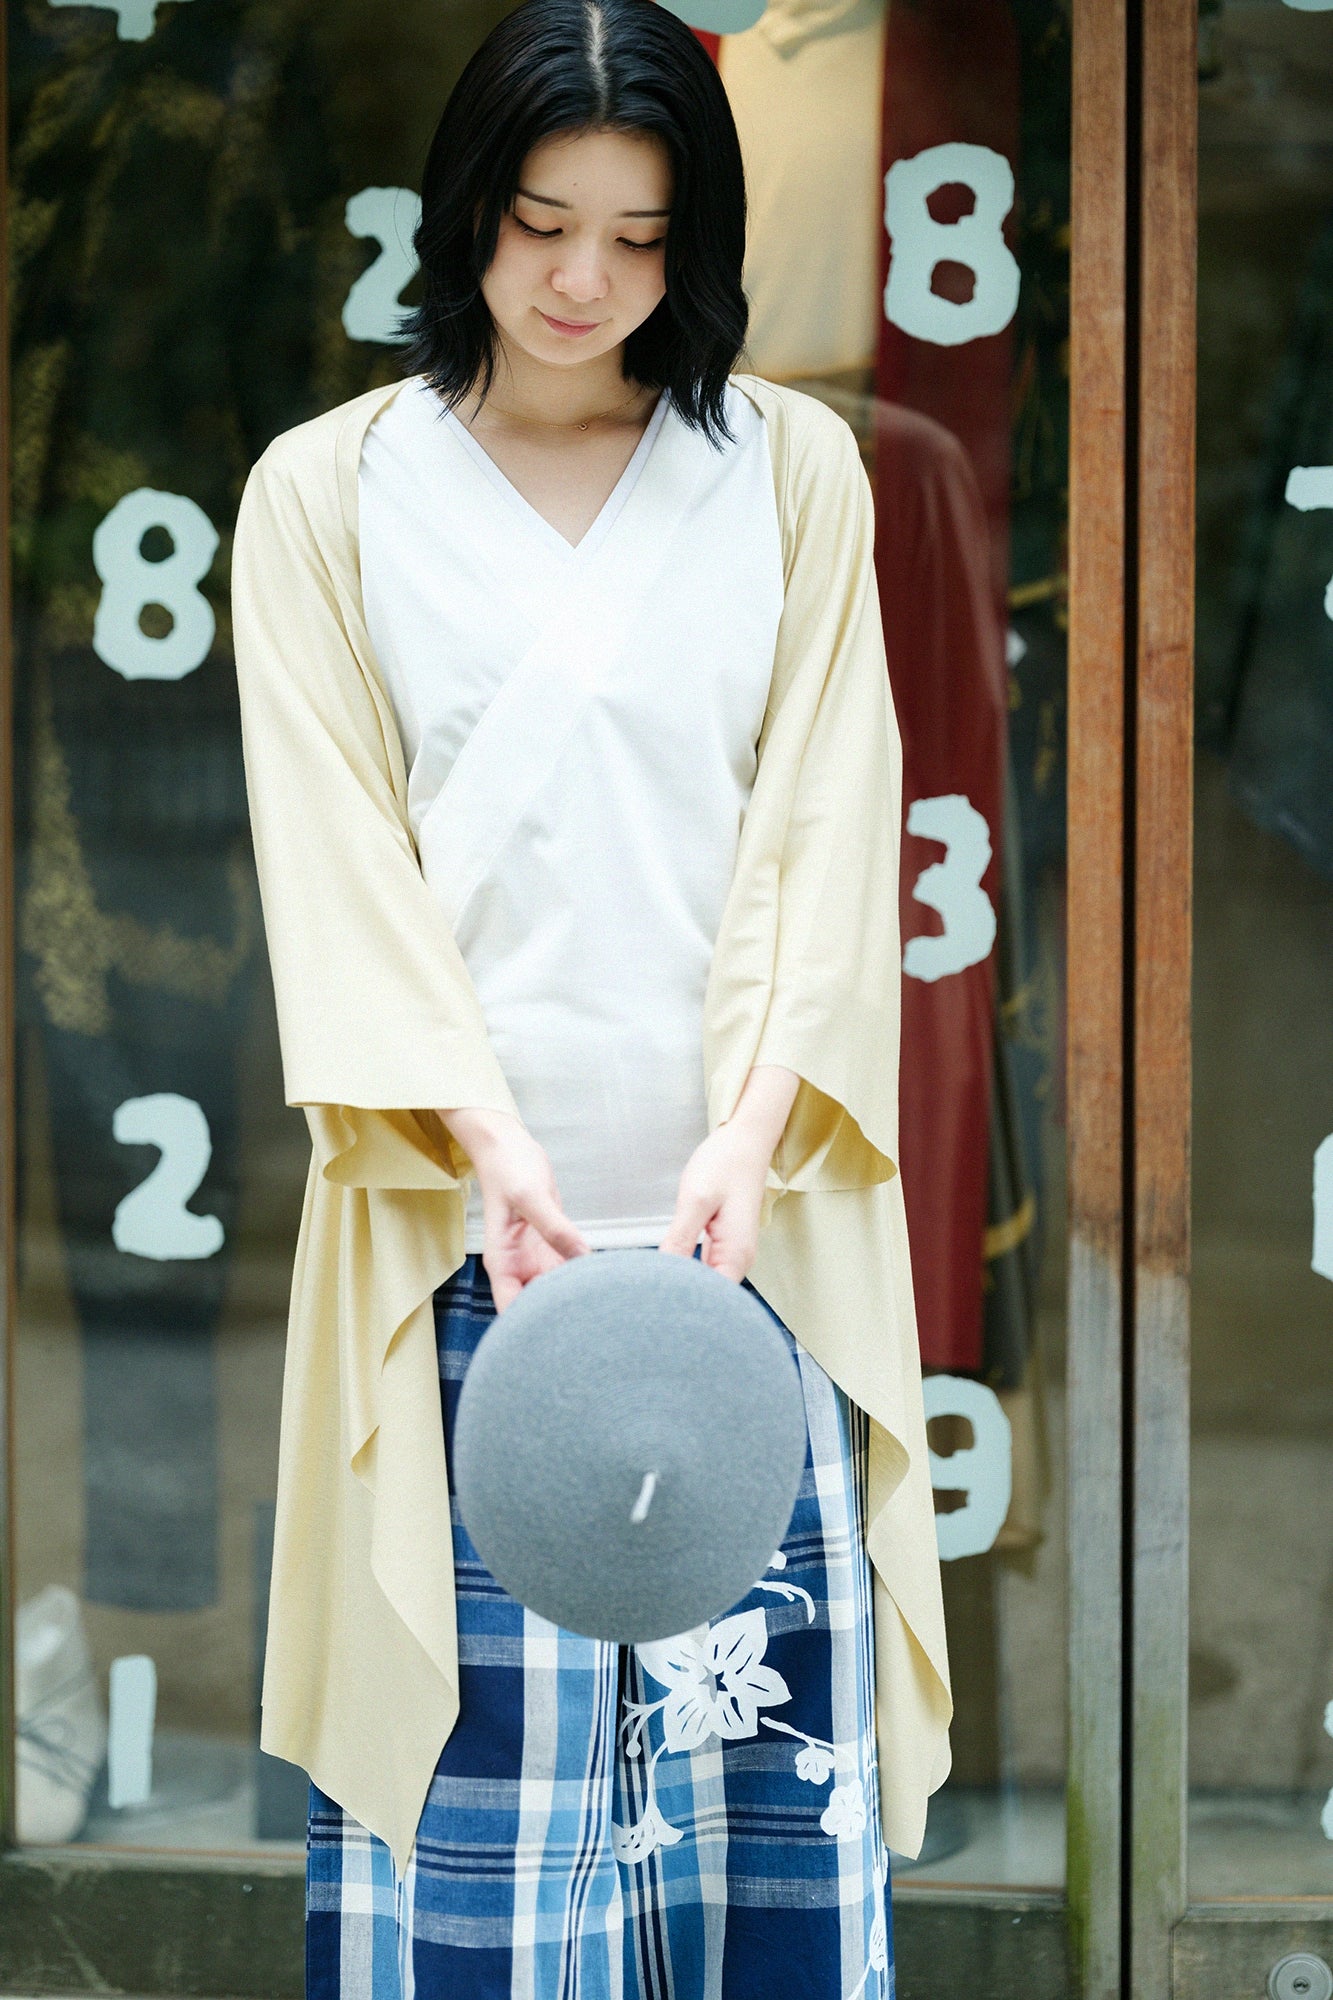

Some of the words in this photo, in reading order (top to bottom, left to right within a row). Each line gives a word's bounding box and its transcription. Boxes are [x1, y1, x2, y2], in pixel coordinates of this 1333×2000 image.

[342, 186, 422, 344] 2
[884, 142, 1021, 347] 8
[93, 487, 219, 681] 8
[903, 794, 997, 983] 3
[112, 1092, 225, 1261] 2
[923, 1375, 1012, 1561] 9
[108, 1655, 156, 1808] 1
